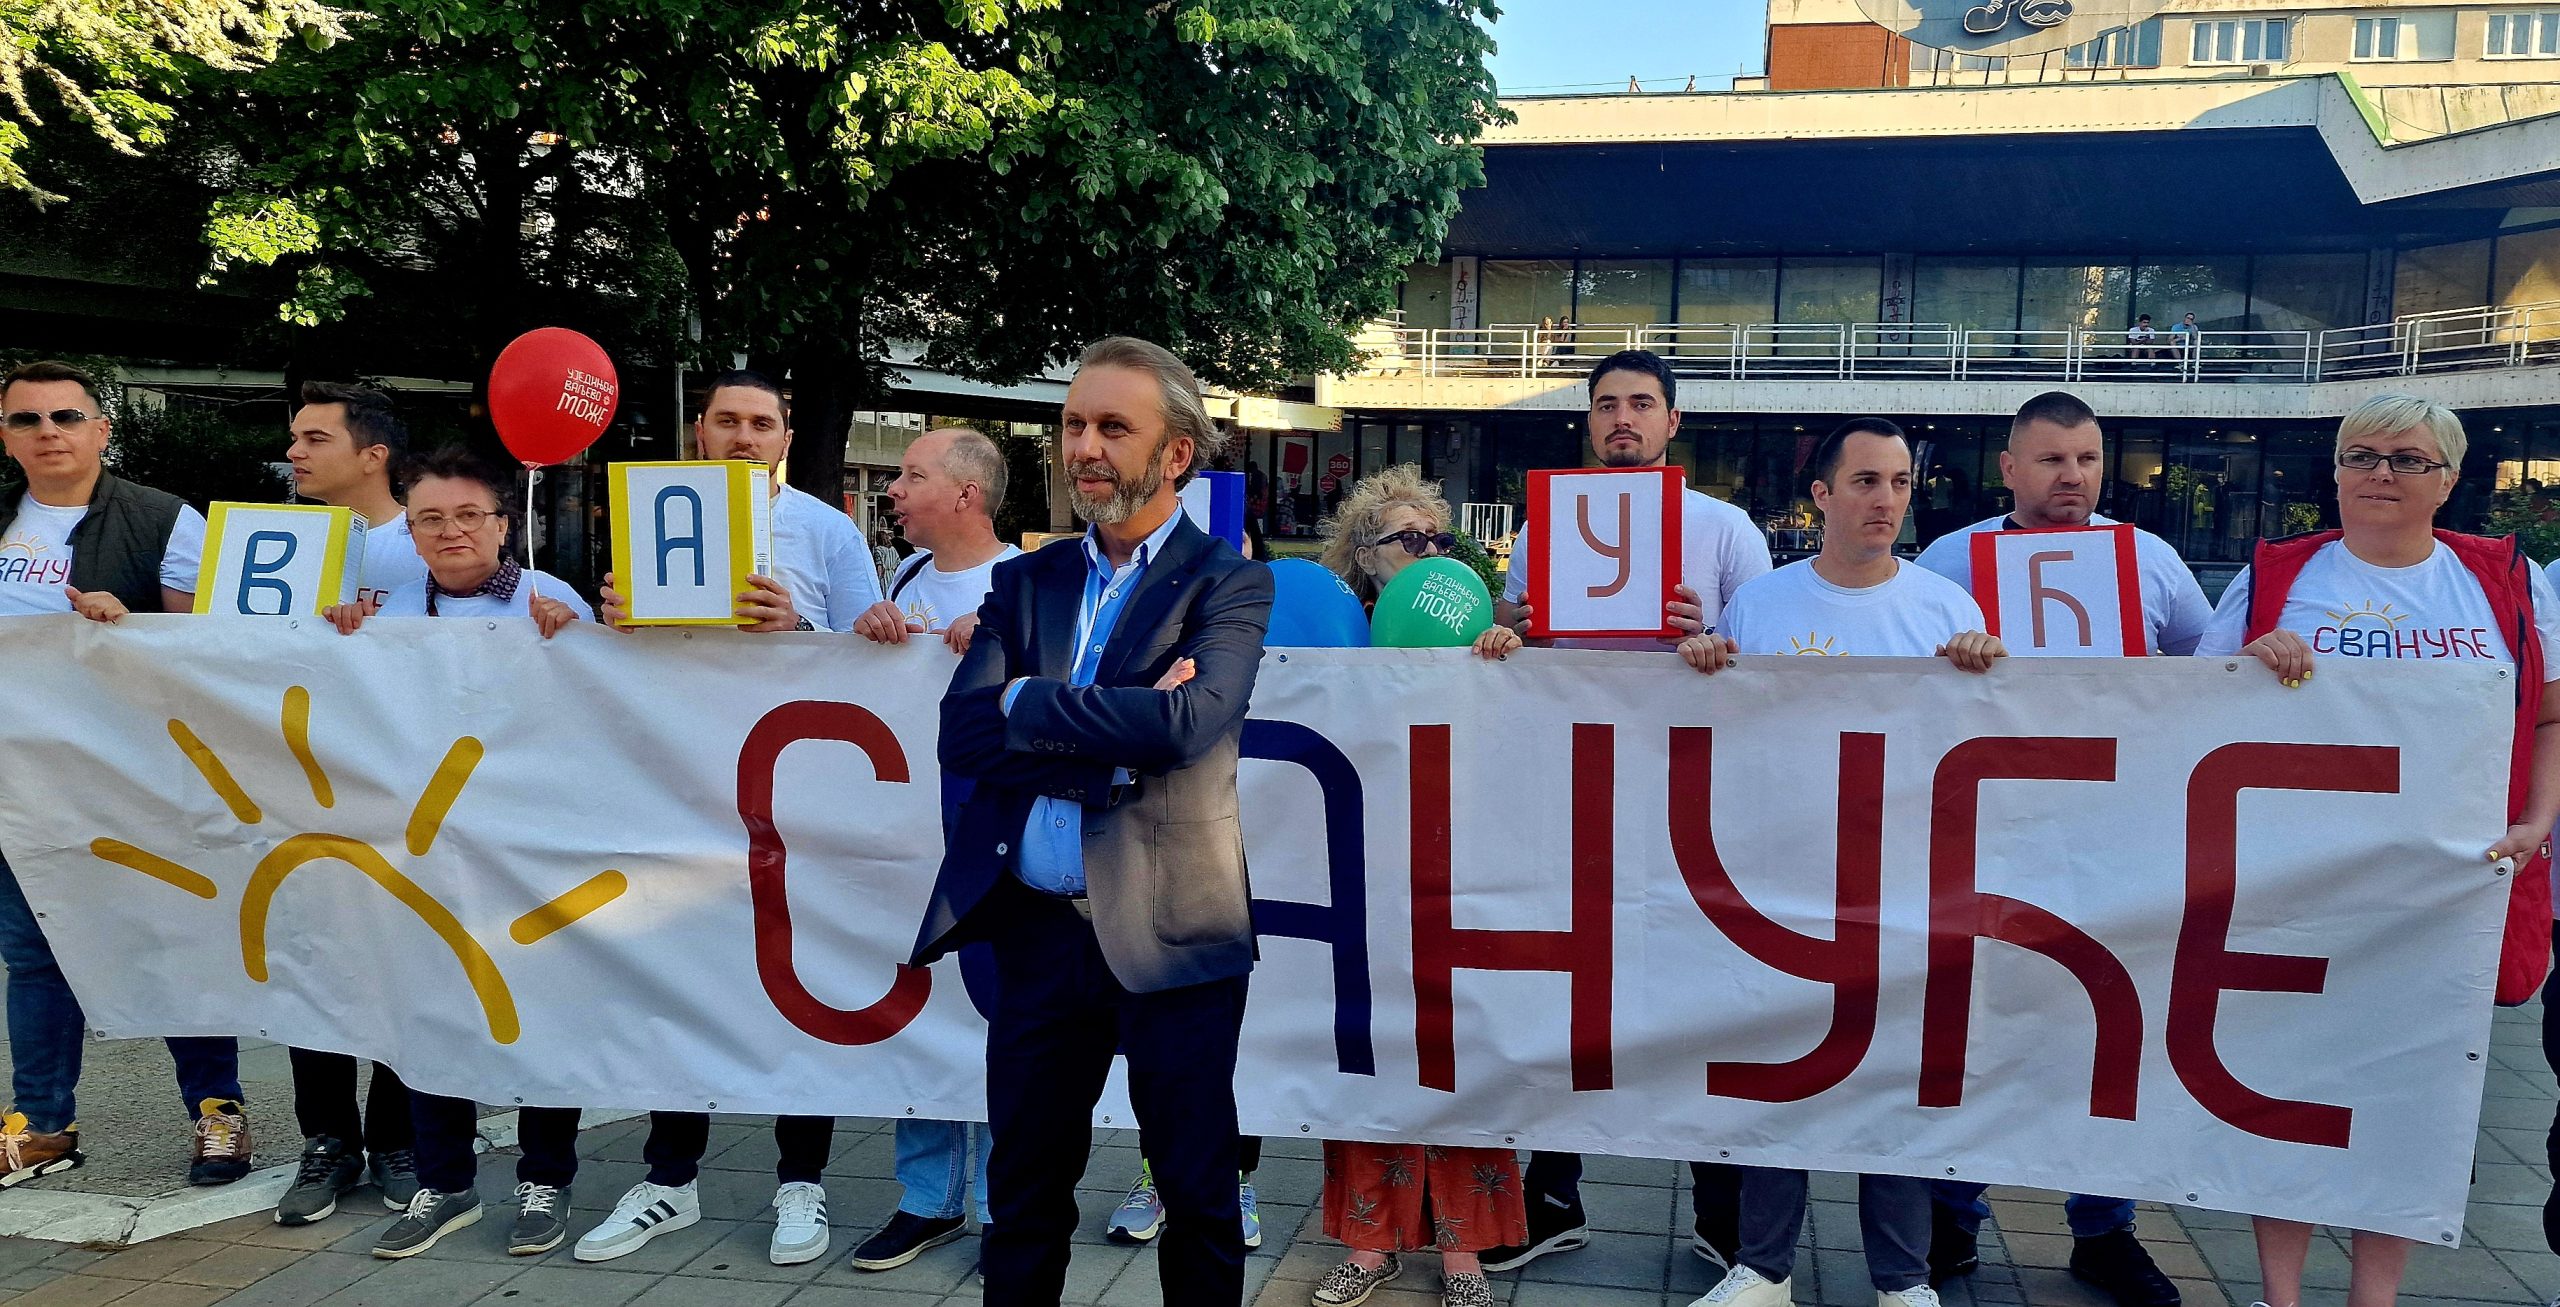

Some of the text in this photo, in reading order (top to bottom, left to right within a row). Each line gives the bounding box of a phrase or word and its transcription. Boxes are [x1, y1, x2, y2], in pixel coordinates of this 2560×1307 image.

[556, 392, 609, 427] МОЖЕ
[564, 380, 602, 402] ВАЉЕВО
[655, 485, 705, 587] А
[1576, 492, 1630, 598] У
[237, 530, 298, 615] В
[1422, 579, 1462, 604] ВАЉЕВО
[1427, 570, 1480, 607] УЈЕДИЊЕНО
[1411, 590, 1470, 636] МОЖЕ
[2312, 626, 2496, 660] СВАНУЋЕ
[737, 699, 2401, 1149] САНУЋЕ
